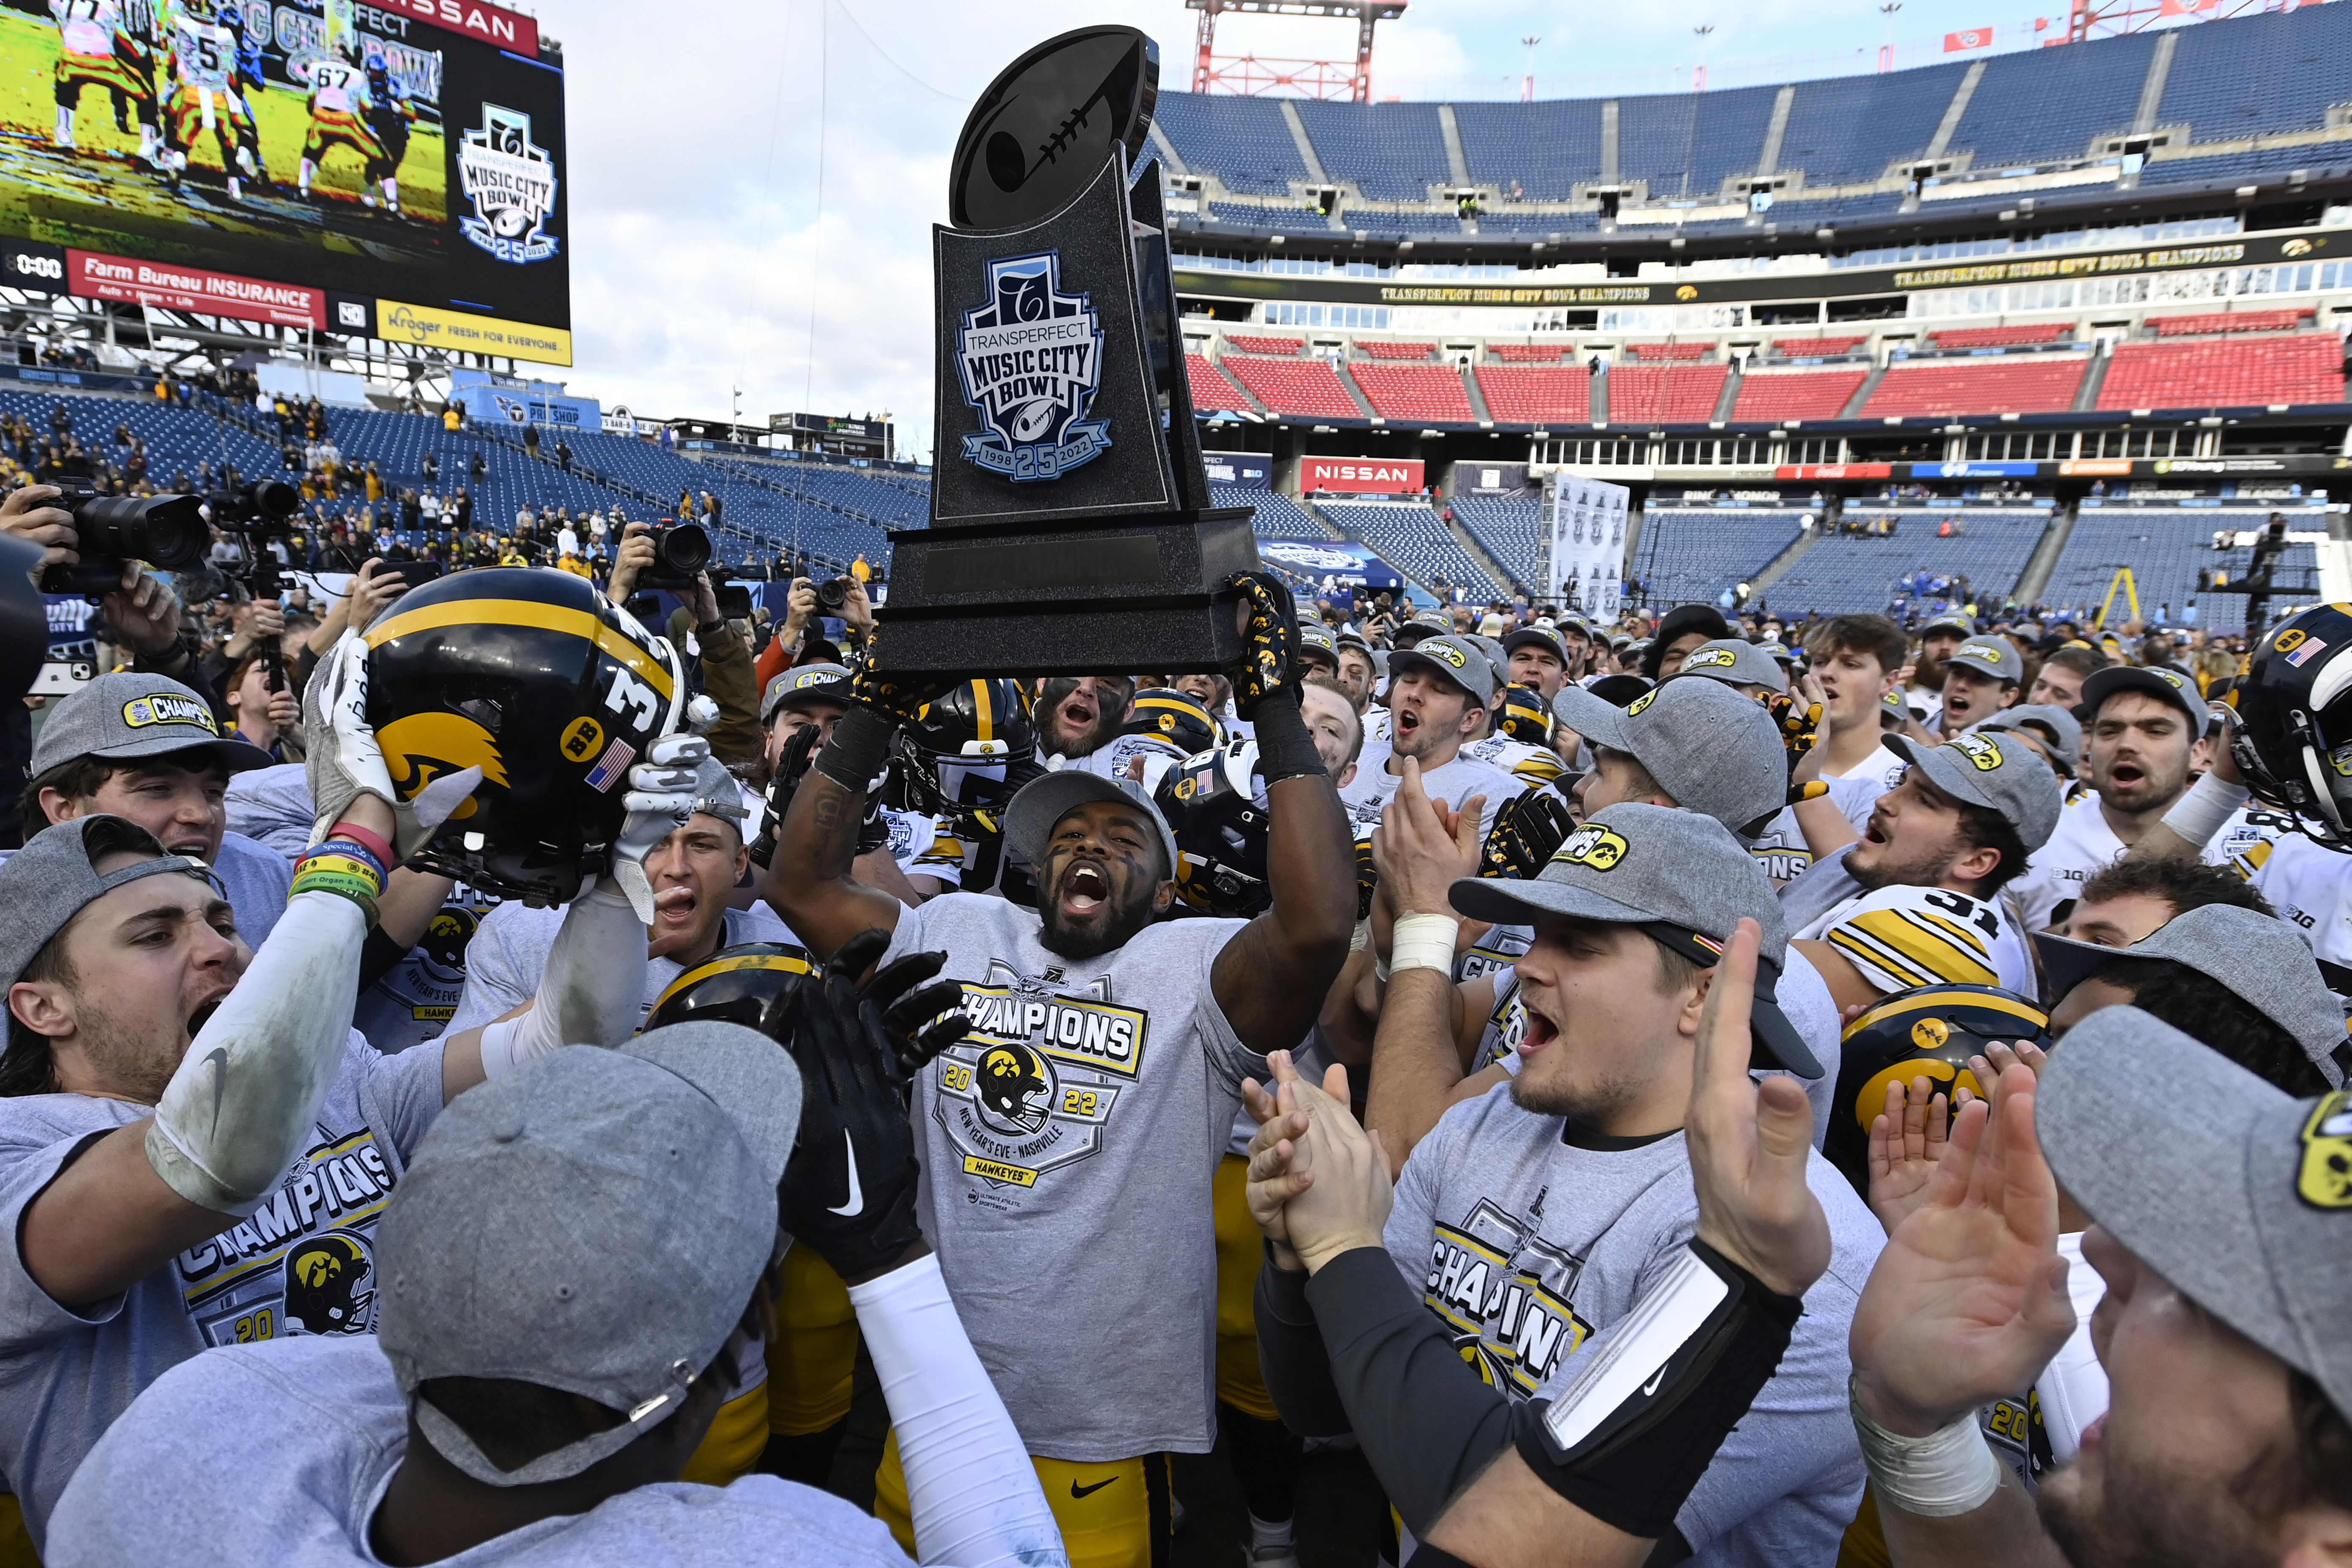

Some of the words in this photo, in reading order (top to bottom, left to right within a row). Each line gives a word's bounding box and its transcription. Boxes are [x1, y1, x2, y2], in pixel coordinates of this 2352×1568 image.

[399, 0, 515, 42] SSAN
[317, 67, 350, 90] 67
[467, 149, 548, 177] TRANSPERFECT
[466, 164, 512, 189] MUSIC
[516, 176, 549, 204] CITY
[487, 190, 531, 215] BOWL
[496, 238, 525, 264] 25
[1895, 264, 2006, 287] TRANSPERFECT
[2007, 259, 2058, 279] MUSIC
[2099, 253, 2143, 272] BOWL
[2147, 244, 2245, 267] CHAMPIONS
[85, 257, 133, 280] Farm
[138, 266, 201, 291] Bureau
[206, 277, 310, 308] INSURANCE
[1381, 288, 1472, 301] TRANSPERFECT
[1473, 289, 1511, 302] MUSIC
[1512, 289, 1542, 302] CITY
[1544, 289, 1577, 302] BOWL
[1579, 287, 1650, 301] CHAMPIONS
[98, 284, 122, 297] Auto
[176, 297, 194, 308] Life
[388, 307, 441, 341] Kroger
[448, 325, 479, 339] FRESH
[483, 331, 503, 342] FOR
[969, 322, 1086, 350] TRANSPERFECT
[968, 349, 1035, 392] MUSIC
[1038, 342, 1090, 378] CITY
[997, 376, 1064, 407] BOWL
[553, 411, 579, 423] SHOP
[610, 420, 646, 430] BAR-B-UE
[984, 450, 1012, 466] 1998
[1015, 443, 1057, 477] 25
[1059, 441, 1089, 461] 2022
[1209, 466, 1236, 481] BOWL
[1315, 465, 1408, 482] NISSAN
[1301, 632, 1323, 643] CHAMPS
[1424, 642, 1454, 659] CHAMPS
[2277, 631, 2302, 649] BB
[813, 672, 844, 684] CHAM
[152, 698, 206, 725] CHAMPS
[565, 721, 598, 757] BB
[893, 830, 909, 838] CITY
[319, 876, 344, 884] Organ
[405, 968, 418, 986] NEW
[416, 983, 441, 1002] YEAR'S
[442, 990, 457, 1002] EVE
[424, 1008, 457, 1018] HAWKE
[945, 1064, 971, 1090] 20
[1064, 1089, 1097, 1116] 22
[958, 1107, 970, 1130] NEW
[969, 1125, 994, 1154] YEAR'S
[995, 1143, 1010, 1159] EVE
[1018, 1124, 1063, 1159] NASHVILLE
[979, 1200, 1008, 1211] SPORTSWEAR
[980, 1193, 1001, 1203] ULTIMATE
[1001, 1198, 1021, 1208] ATHLETIC
[235, 1308, 273, 1344] 20
[1989, 1402, 2027, 1443] 20
